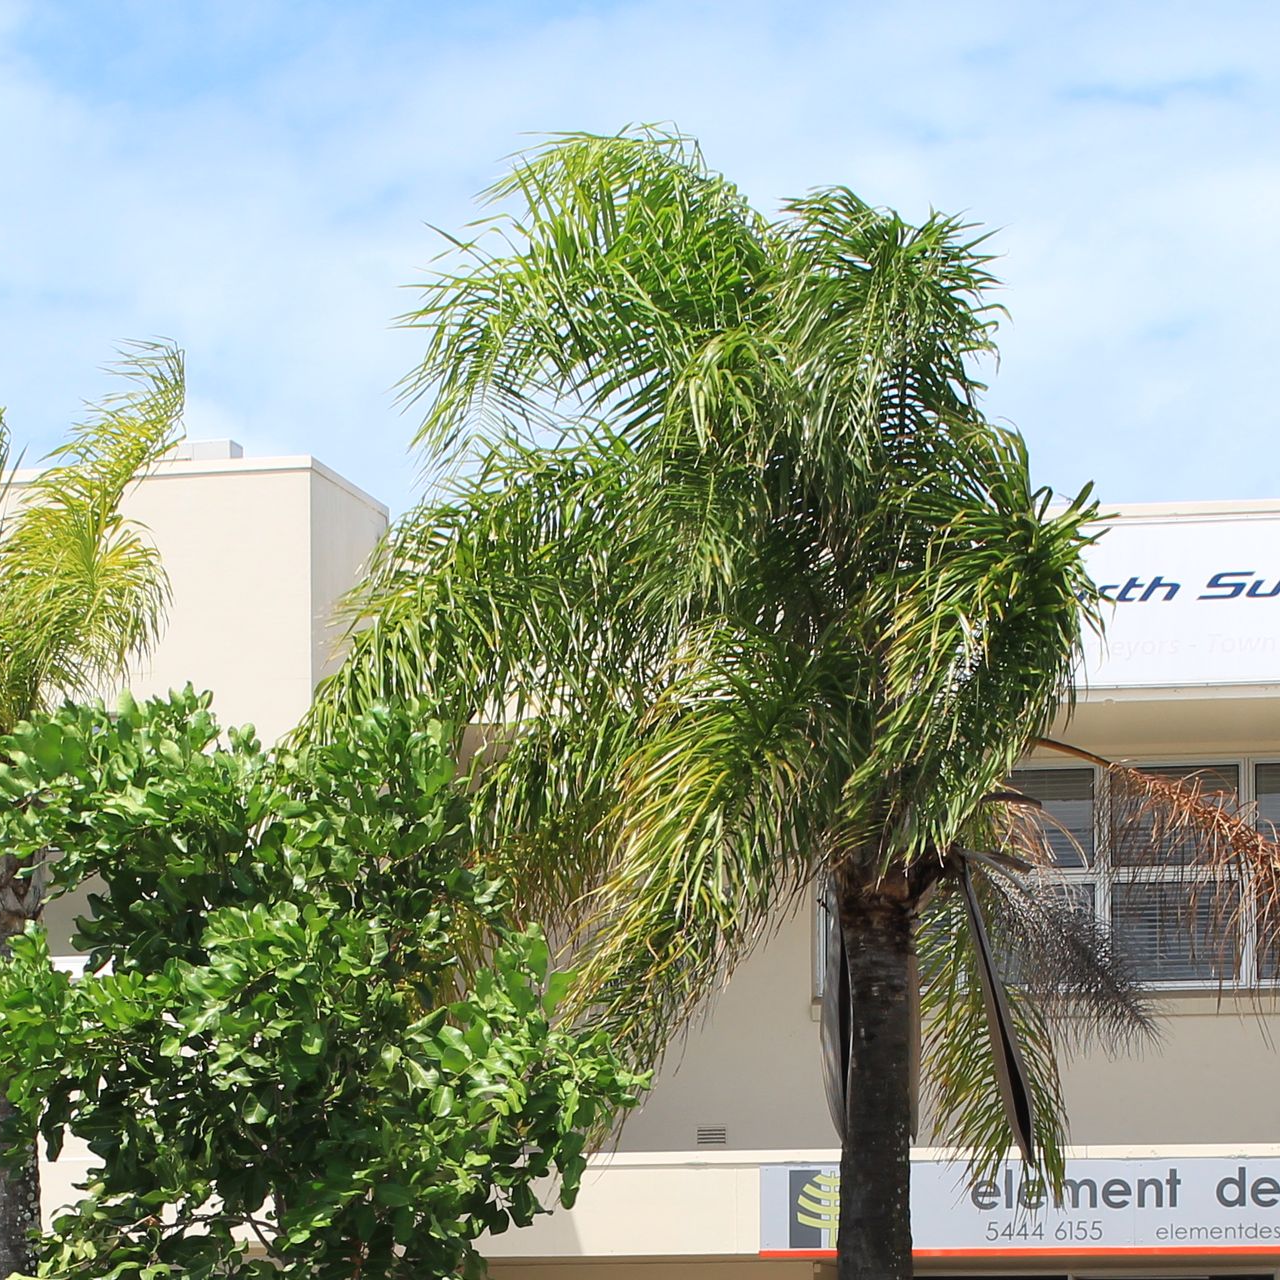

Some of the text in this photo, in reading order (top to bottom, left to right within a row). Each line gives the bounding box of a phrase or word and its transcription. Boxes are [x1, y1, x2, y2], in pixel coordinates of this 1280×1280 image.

[1074, 576, 1181, 602] rth
[971, 1168, 1182, 1210] element
[985, 1221, 1103, 1241] 5444 6155
